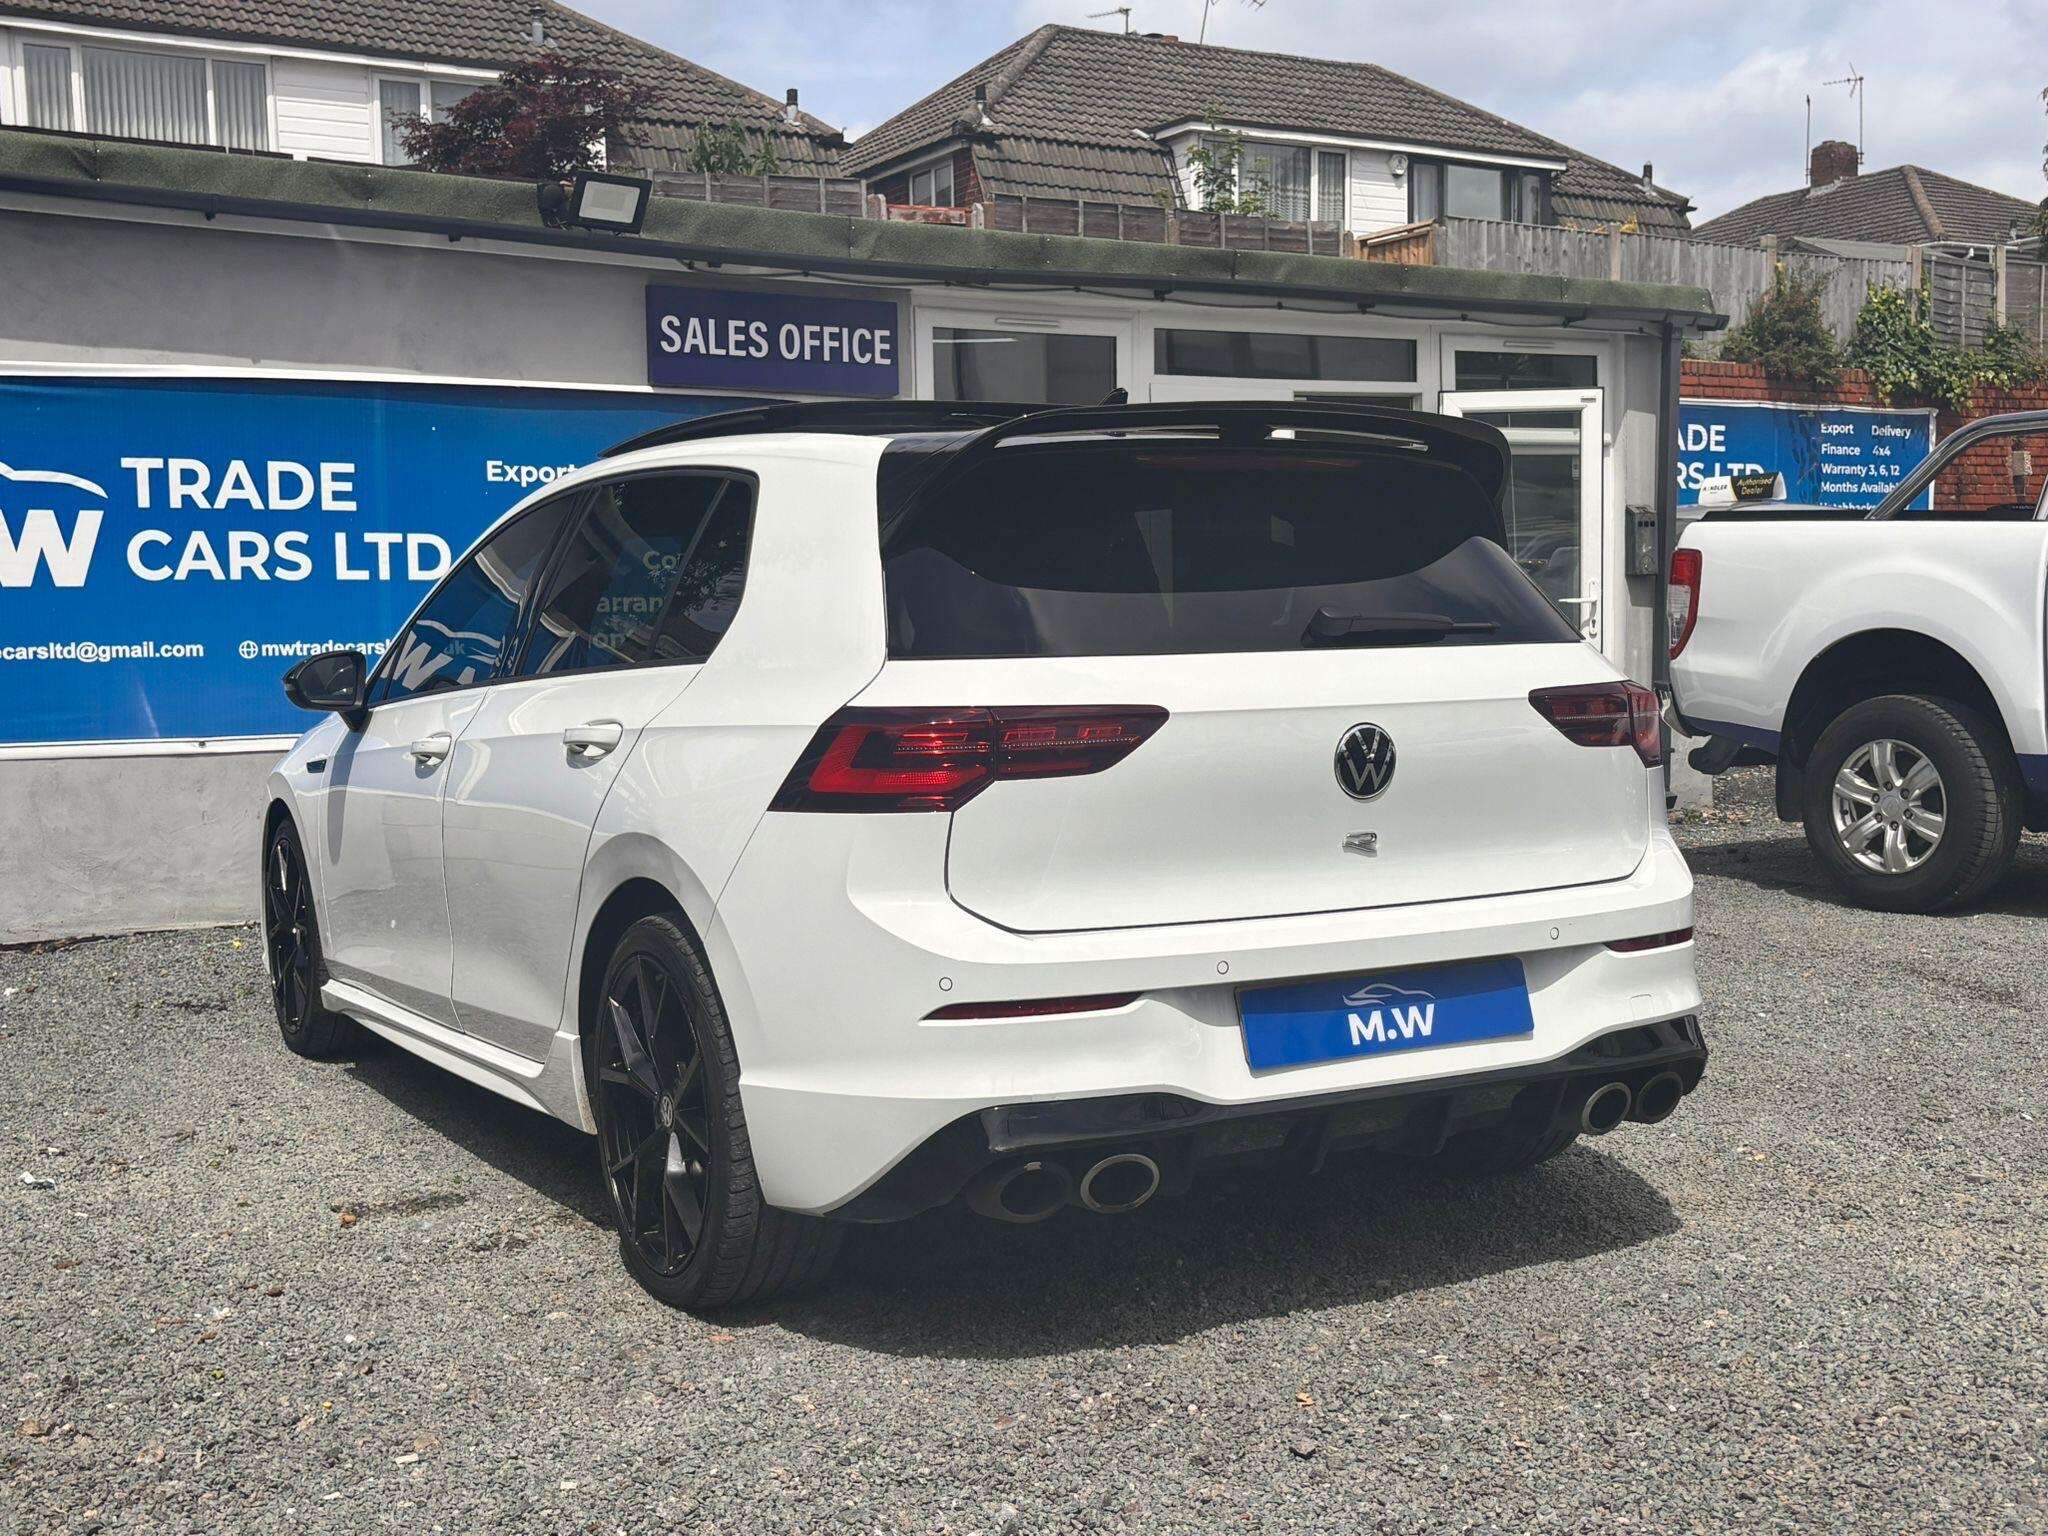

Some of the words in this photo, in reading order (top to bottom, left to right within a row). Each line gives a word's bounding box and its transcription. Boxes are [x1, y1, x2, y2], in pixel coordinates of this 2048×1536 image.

[660, 314, 769, 359] SALES
[779, 323, 892, 365] OFFICE
[1820, 423, 1854, 436] Export
[1871, 424, 1912, 439] Delivery
[1820, 443, 1861, 456] Finance
[1872, 445, 1892, 457] 4x4
[1821, 463, 1867, 477] Warranty
[1868, 464, 1878, 477] 3,
[1879, 465, 1889, 476] 6,
[1890, 465, 1900, 476] 12
[120, 457, 357, 512] TRADE
[1821, 482, 1858, 493] Months
[1859, 482, 1899, 494] Availab
[126, 529, 313, 581] CARS
[335, 532, 452, 581] LTD
[0, 641, 204, 663] carsltd@gmail.com
[1347, 1003, 1435, 1046] M.W
